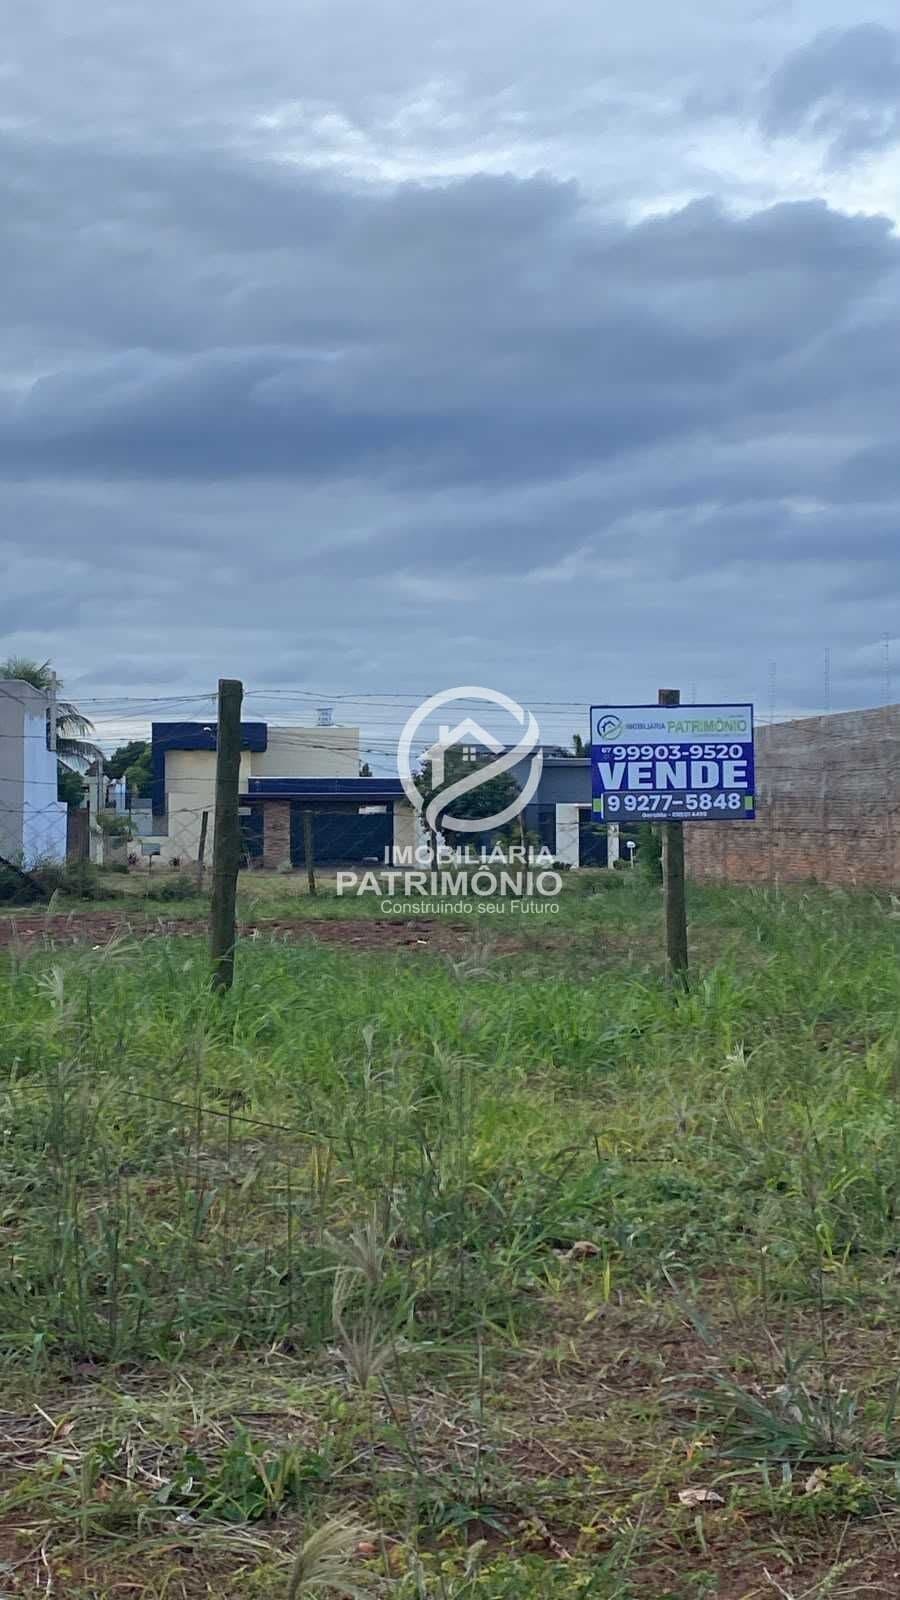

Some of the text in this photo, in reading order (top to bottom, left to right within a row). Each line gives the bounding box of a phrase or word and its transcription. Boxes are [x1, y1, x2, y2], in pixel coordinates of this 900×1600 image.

[613, 745, 743, 760] 99903-9520
[597, 760, 748, 790] VENDE
[624, 793, 741, 811] 9277-5848
